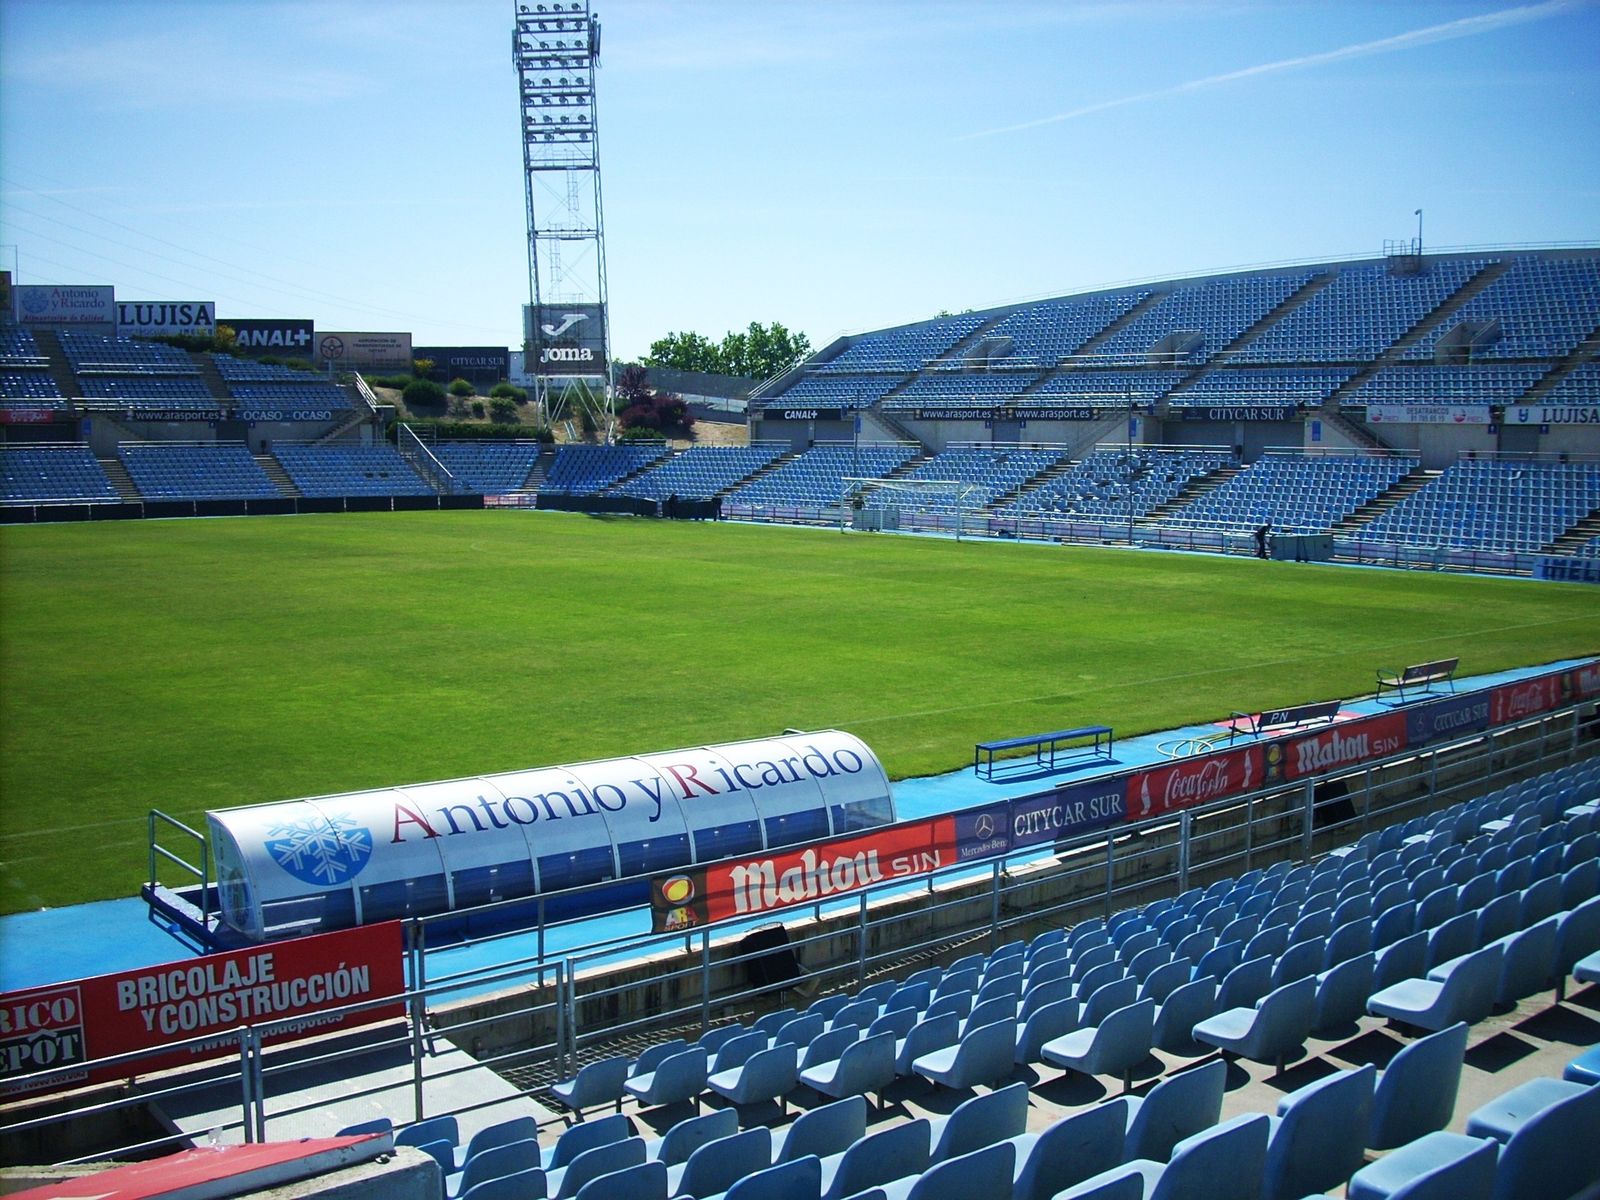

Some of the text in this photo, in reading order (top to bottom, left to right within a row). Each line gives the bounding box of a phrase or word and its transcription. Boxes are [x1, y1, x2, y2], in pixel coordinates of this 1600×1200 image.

[52, 287, 99, 298] Antonio
[61, 298, 105, 308] Ricardo
[119, 304, 213, 325] LUJISA
[235, 328, 311, 347] ANAL+
[450, 357, 505, 366] CITYCAR SUR
[135, 410, 220, 422] www.arasport.es
[243, 410, 332, 421] OCASO OCASO
[784, 410, 818, 420] CANAL+
[922, 409, 992, 420] www.arasport.es
[1015, 409, 1090, 420] www.arasport.es
[1209, 408, 1284, 420] CITYCAR SUR
[1542, 408, 1600, 423] LUJISA
[1296, 731, 1399, 773] Mahou SIN
[391, 742, 865, 844] Antonio y Ricardo
[1014, 793, 1123, 837] CITYCAR SUR
[729, 848, 941, 914] Mahou SIN
[666, 906, 698, 926] ARA
[117, 952, 275, 1012] BRICOLAJE
[141, 962, 371, 1036] Y CONSTRUCCIÓN
